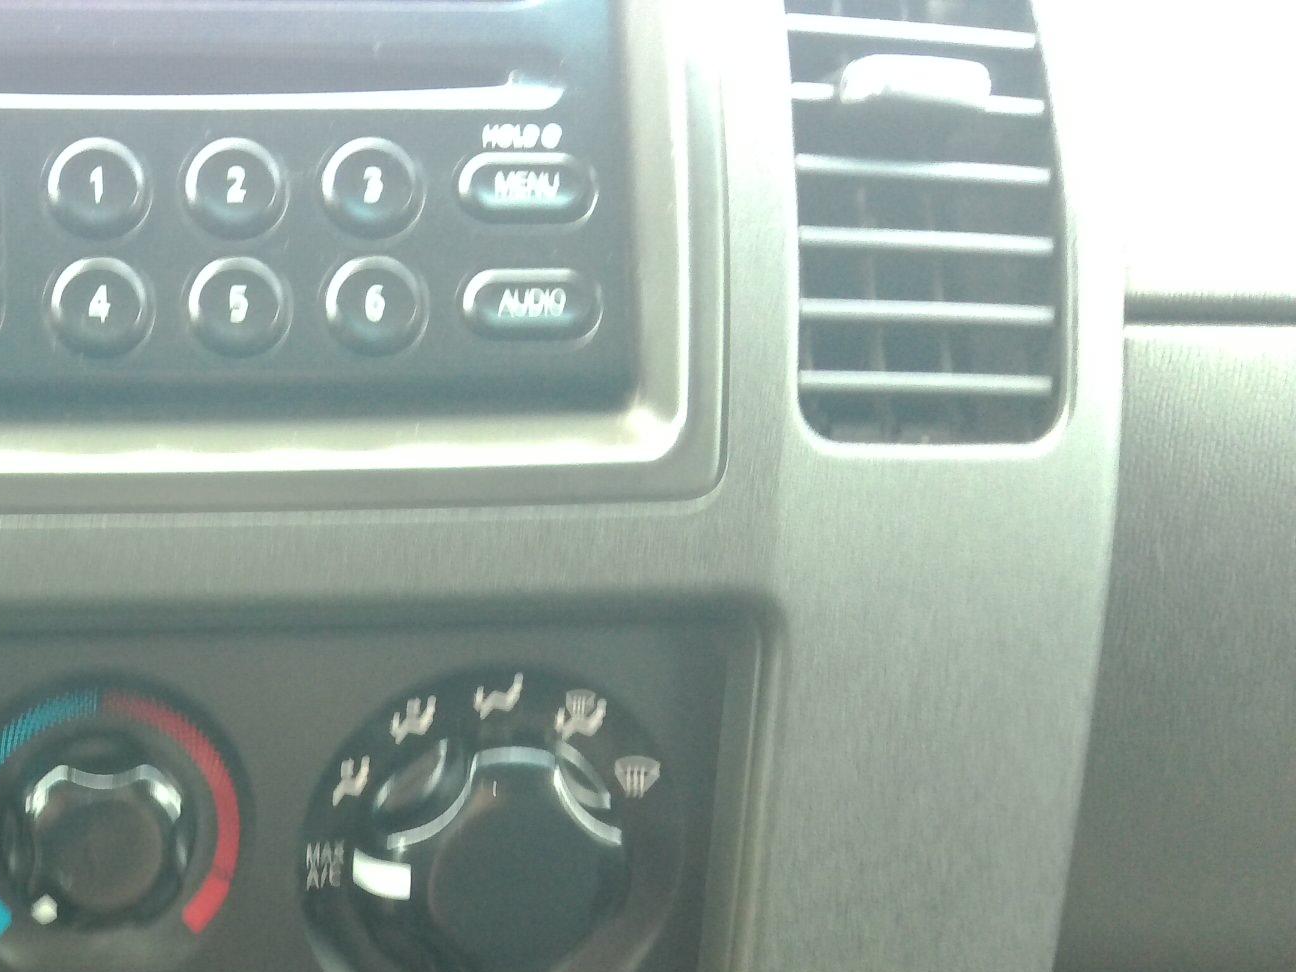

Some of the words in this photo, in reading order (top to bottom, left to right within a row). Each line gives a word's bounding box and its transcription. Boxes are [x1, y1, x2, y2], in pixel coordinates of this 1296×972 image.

[87, 165, 104, 203] 1
[226, 165, 247, 204] 2
[362, 165, 384, 204] 3
[494, 170, 560, 200] MENU
[88, 284, 111, 323] 4
[228, 284, 249, 324] 5
[364, 284, 386, 323] 6
[497, 287, 567, 318] AUDIO
